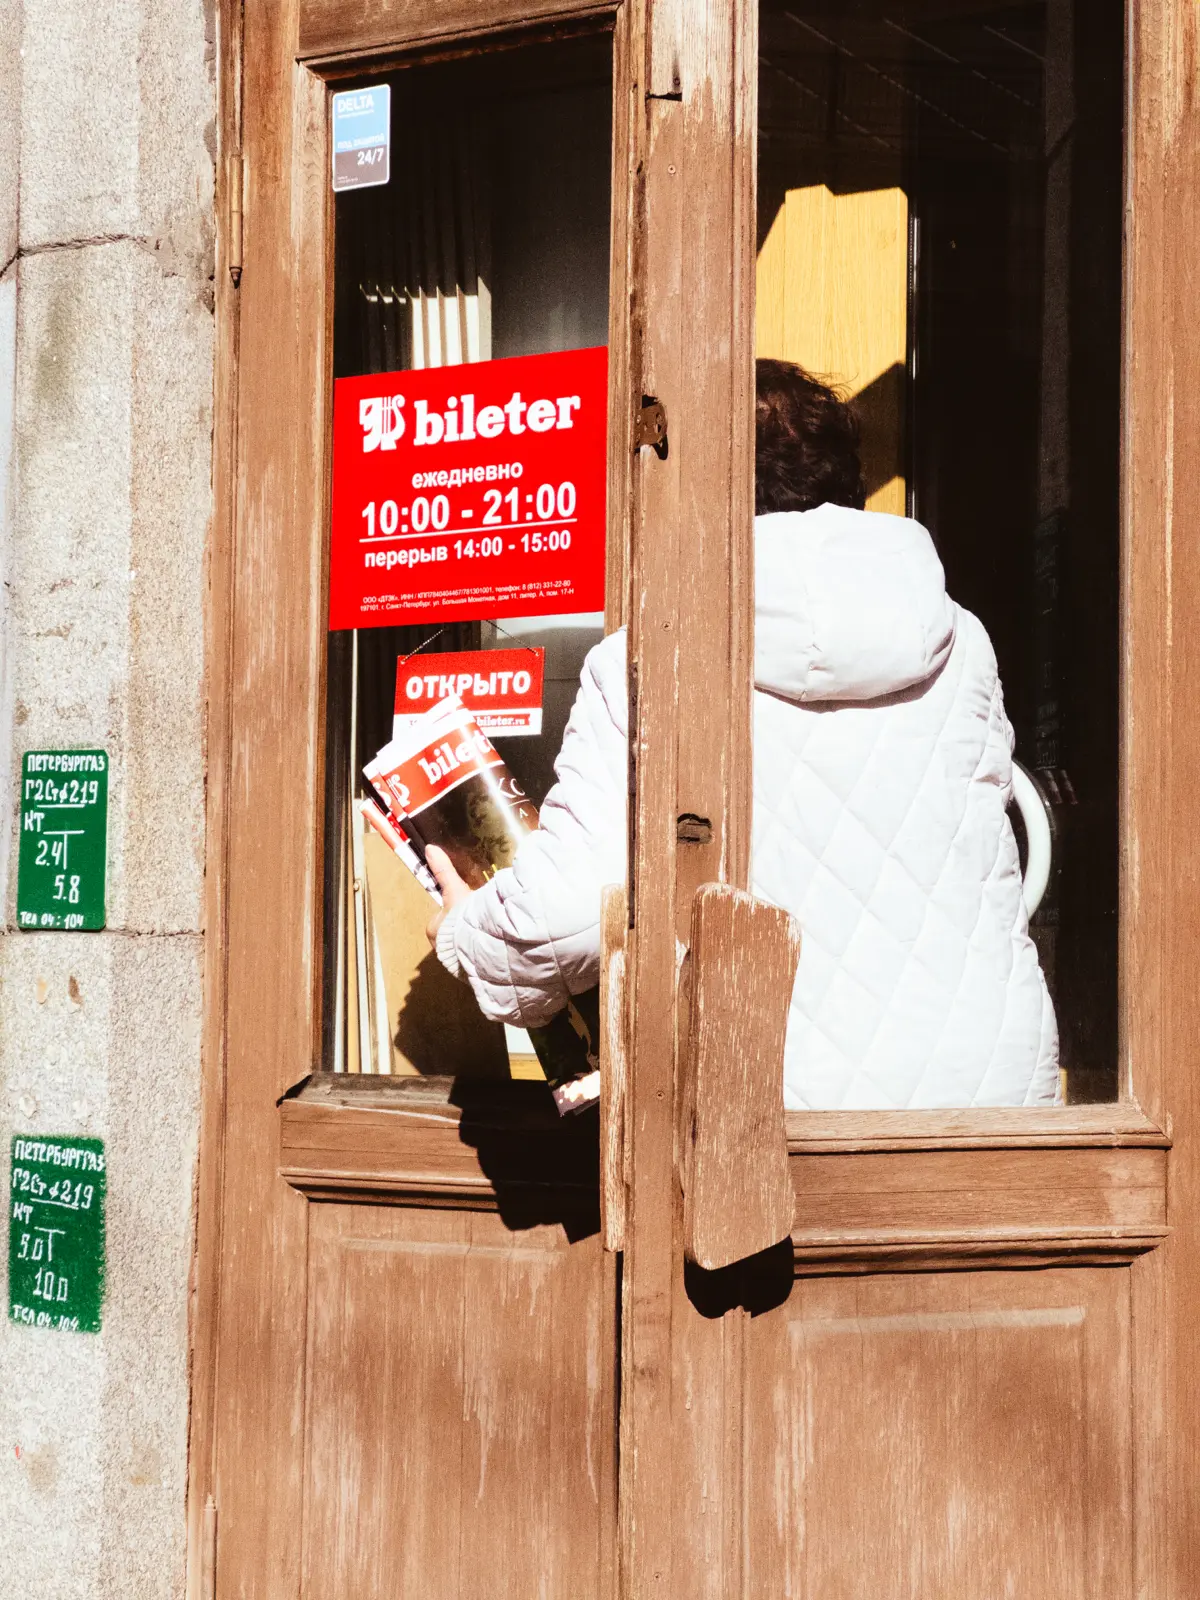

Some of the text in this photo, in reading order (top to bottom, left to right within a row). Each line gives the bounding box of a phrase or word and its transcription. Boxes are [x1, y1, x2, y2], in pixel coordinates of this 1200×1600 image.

[338, 95, 374, 112] DELTA
[357, 147, 384, 166] 24/7
[414, 392, 580, 445] bileter
[412, 462, 523, 488] ежедневно
[362, 482, 575, 536] 10:00 - 21:00
[365, 546, 447, 570] перерыв
[454, 537, 502, 559] 14:00
[521, 530, 570, 552] 15:00
[527, 582, 542, 590] (812)
[406, 671, 531, 699] ОТКРЫТО
[25, 810, 44, 832] КТ
[36, 840, 62, 865] 2.4
[53, 875, 80, 903] 5.8
[13, 1202, 33, 1224] КТ
